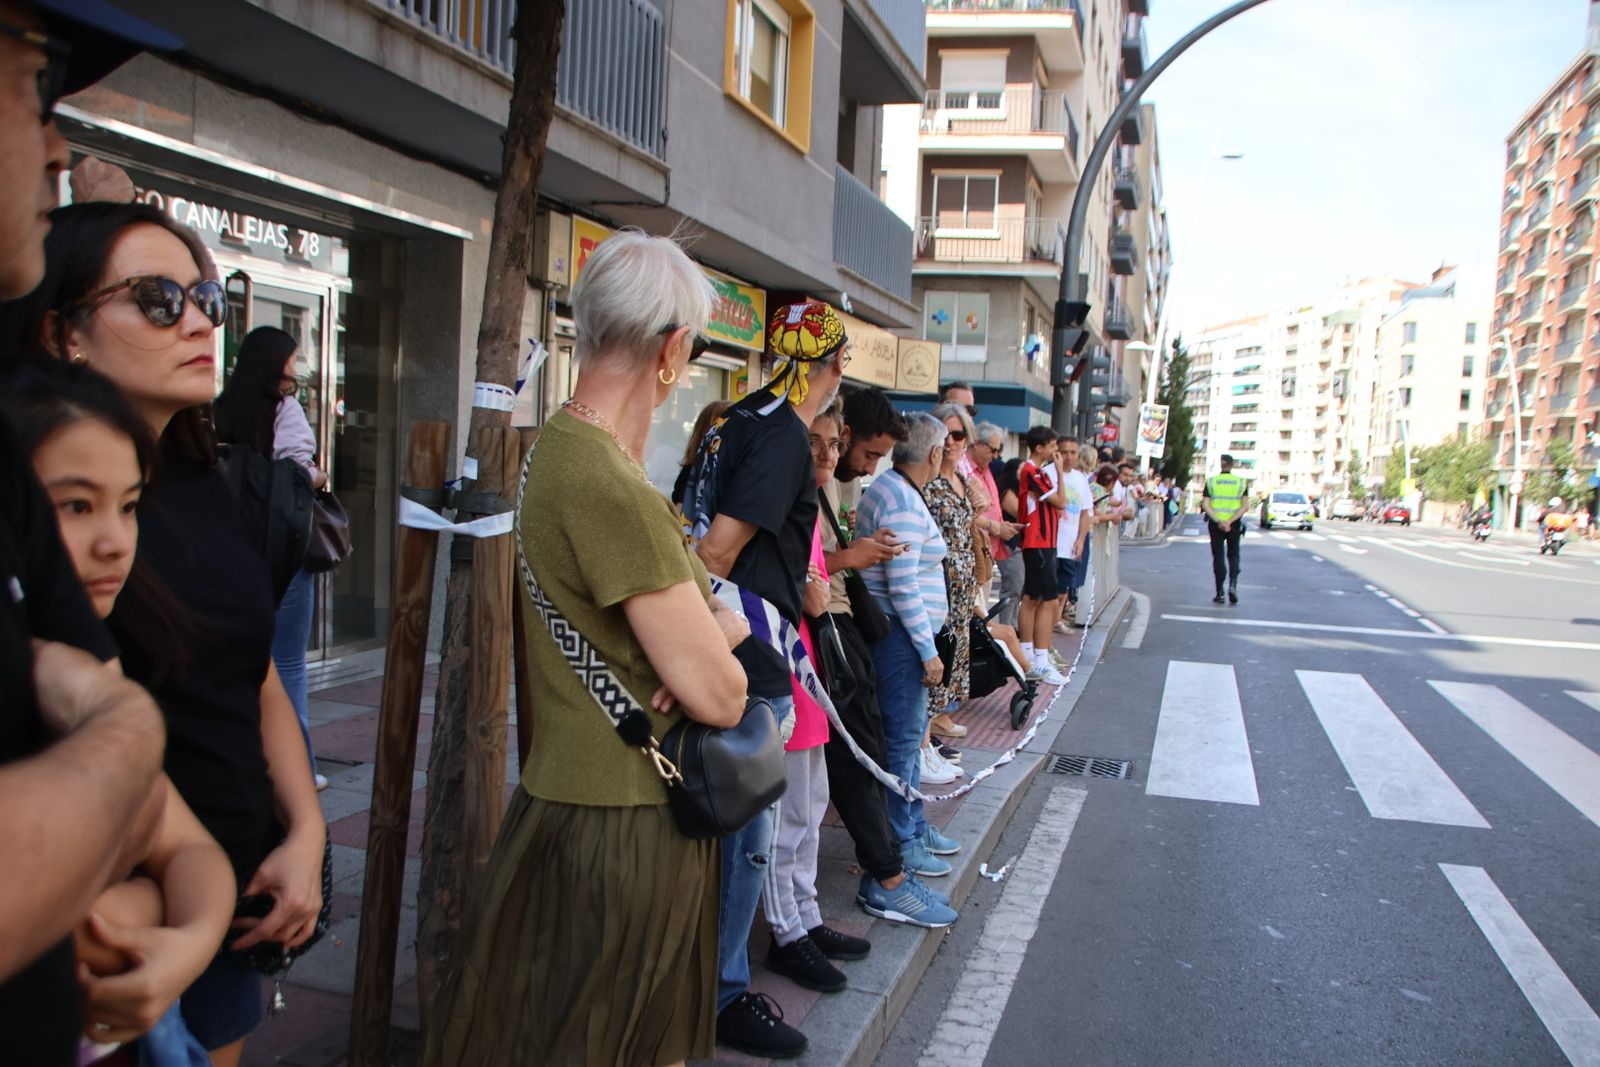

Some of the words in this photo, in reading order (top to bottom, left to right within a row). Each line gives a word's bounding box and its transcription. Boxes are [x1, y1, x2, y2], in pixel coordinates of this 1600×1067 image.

[171, 197, 294, 255] CANALEJAS,
[297, 228, 320, 257] 78
[707, 294, 754, 333] STILLA
